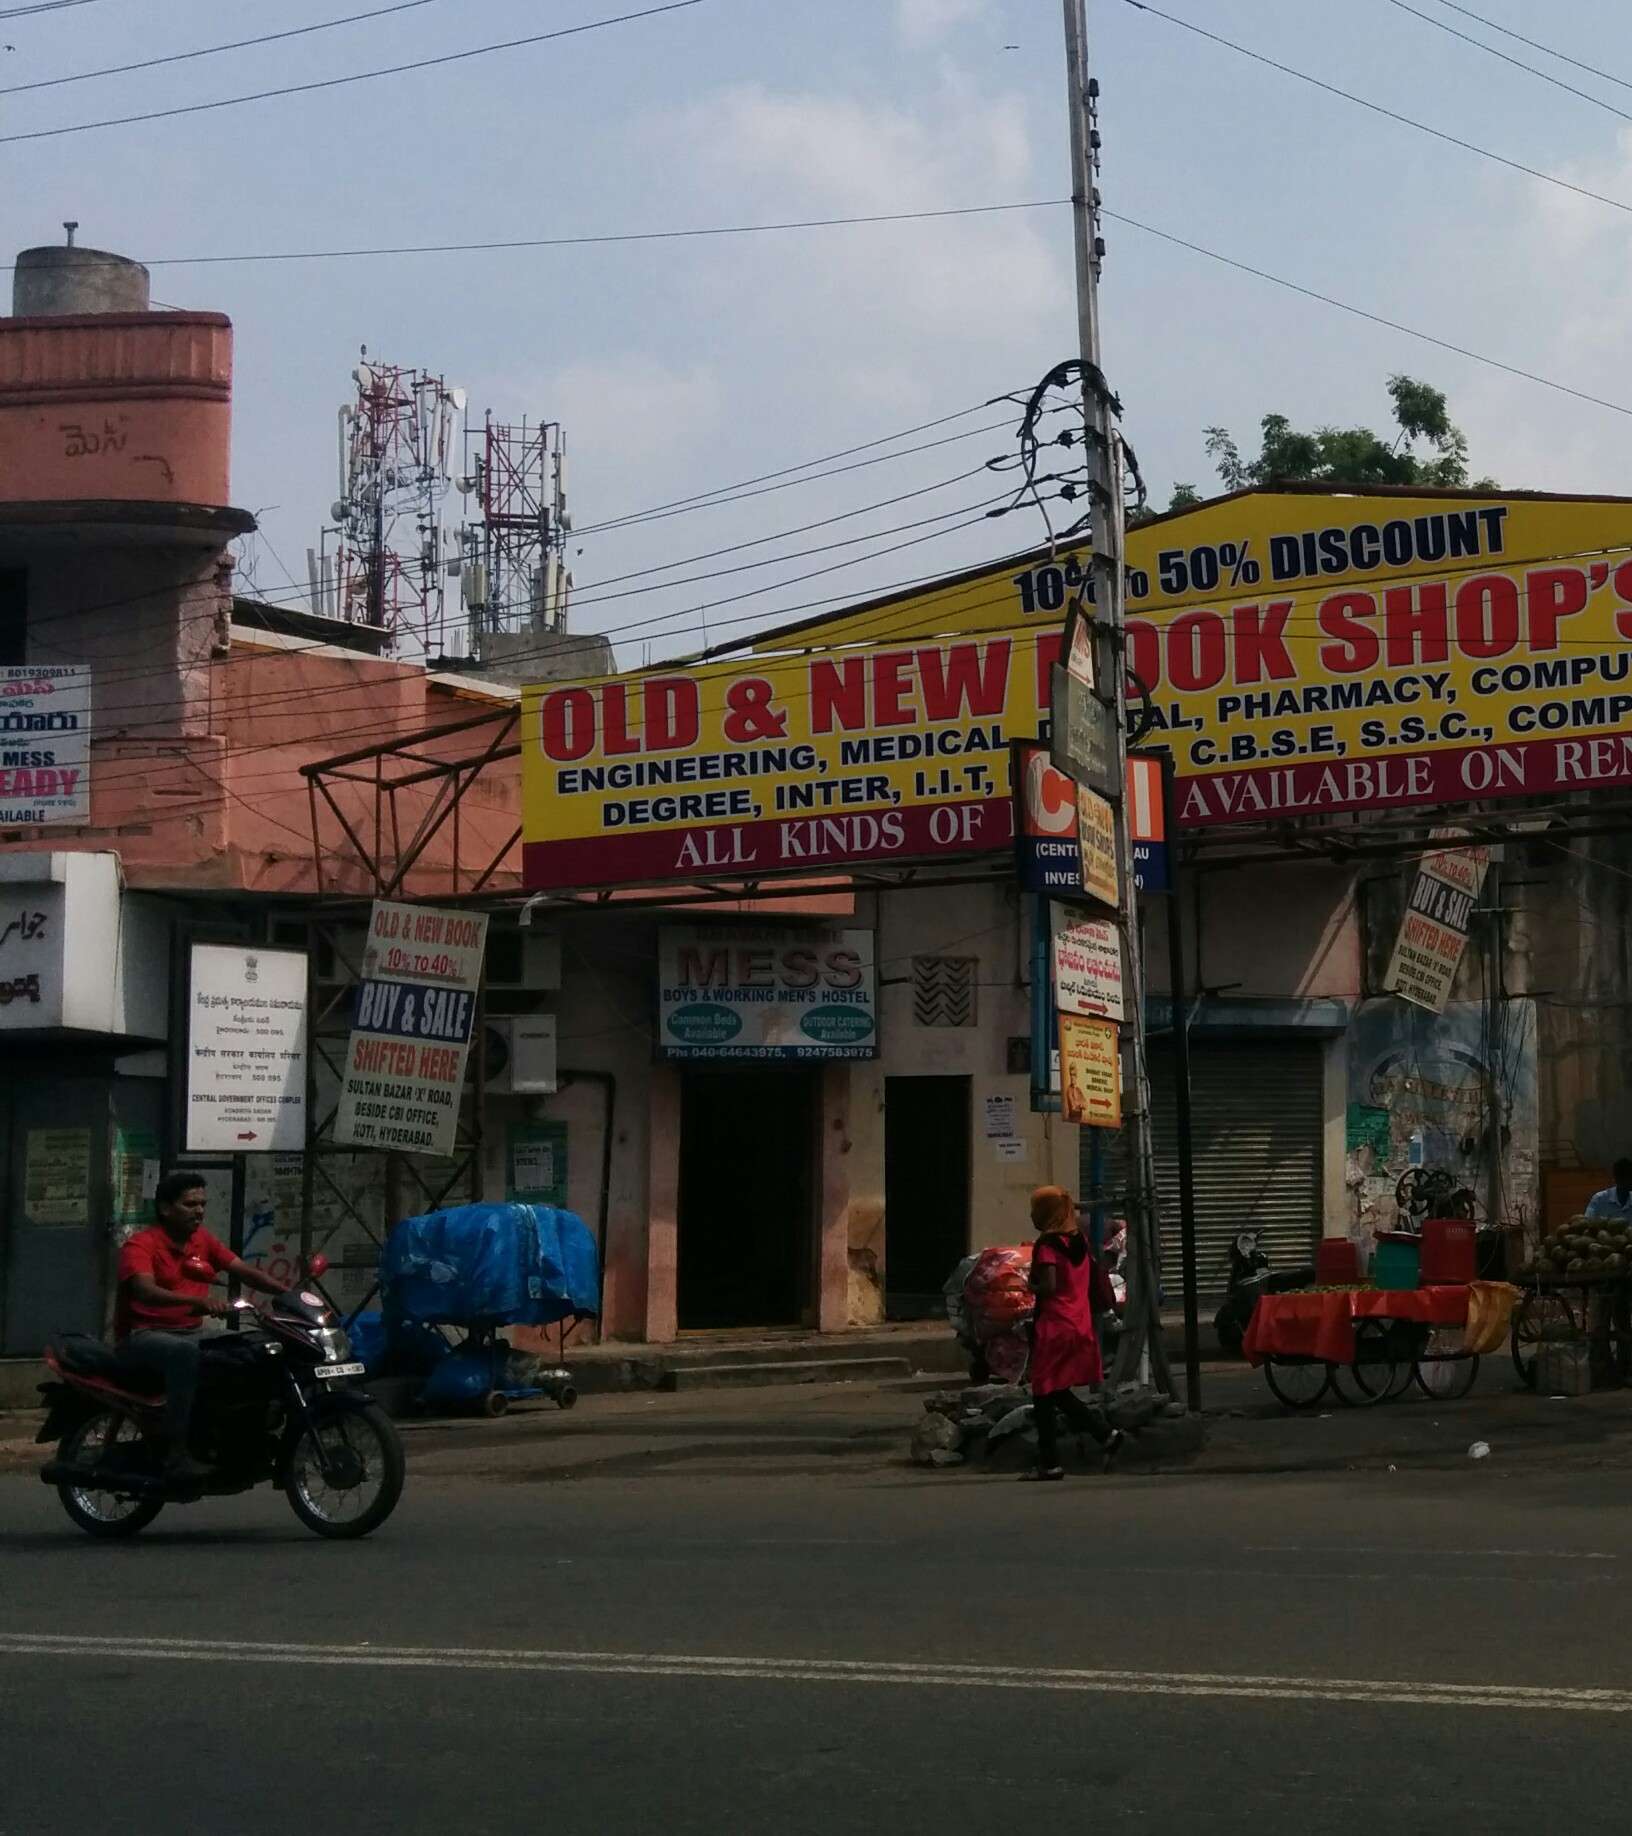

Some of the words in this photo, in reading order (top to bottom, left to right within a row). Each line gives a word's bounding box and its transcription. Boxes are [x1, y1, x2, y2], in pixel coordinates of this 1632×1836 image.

[1159, 541, 1260, 594] 50%
[1269, 508, 1508, 581] DISCOUNT
[542, 677, 699, 762] OLD
[724, 679, 788, 743] &
[809, 638, 1011, 735] NEW
[558, 745, 827, 794] ENGINEERING,
[841, 725, 1010, 766] MEDICAL
[1218, 672, 1457, 724] PHARMACY,
[3, 750, 56, 768] MESS
[603, 789, 762, 827] DEGREE,
[775, 775, 901, 811] INTER,
[915, 765, 994, 796] I.I.T,
[1190, 725, 1346, 766] C.B.S.E,
[1361, 712, 1494, 748] S.S.C.,
[0, 768, 79, 797] EADY
[1026, 751, 1152, 838] CI
[0, 810, 46, 824] AILABLE
[675, 828, 757, 868] ALL
[780, 812, 905, 858] KINDS
[929, 804, 985, 844] OF
[1181, 756, 1434, 818] AVAILABLE
[1461, 746, 1529, 791] ON
[1413, 875, 1442, 914] BUY
[375, 910, 396, 939] OLD
[402, 915, 412, 940] &
[416, 915, 442, 945] NEW
[444, 919, 480, 949] BOOK
[387, 947, 411, 968] 10%
[414, 954, 428, 971] TO
[431, 951, 457, 976] 40%
[677, 944, 865, 991] MESS
[359, 981, 400, 1032] BUY
[402, 992, 416, 1033] &
[420, 989, 468, 1039] SALE
[663, 989, 697, 1002] BOYS
[714, 989, 774, 1002] WORKING
[777, 990, 816, 1003] MEN'S
[822, 990, 870, 1003] HOSTEL
[684, 1028, 728, 1041] Available
[353, 1039, 416, 1078] SHIFTED
[419, 1048, 460, 1083] HERE
[347, 1078, 382, 1097] SULTAN
[383, 1083, 412, 1101] BAZAR
[427, 1089, 453, 1108] ROAD,
[354, 1101, 386, 1118] BESIDE
[388, 1105, 404, 1120] CBI
[405, 1107, 439, 1128] OFFICE,
[353, 1124, 377, 1141] KOTI,
[379, 1127, 433, 1147] HYDERABAD.
